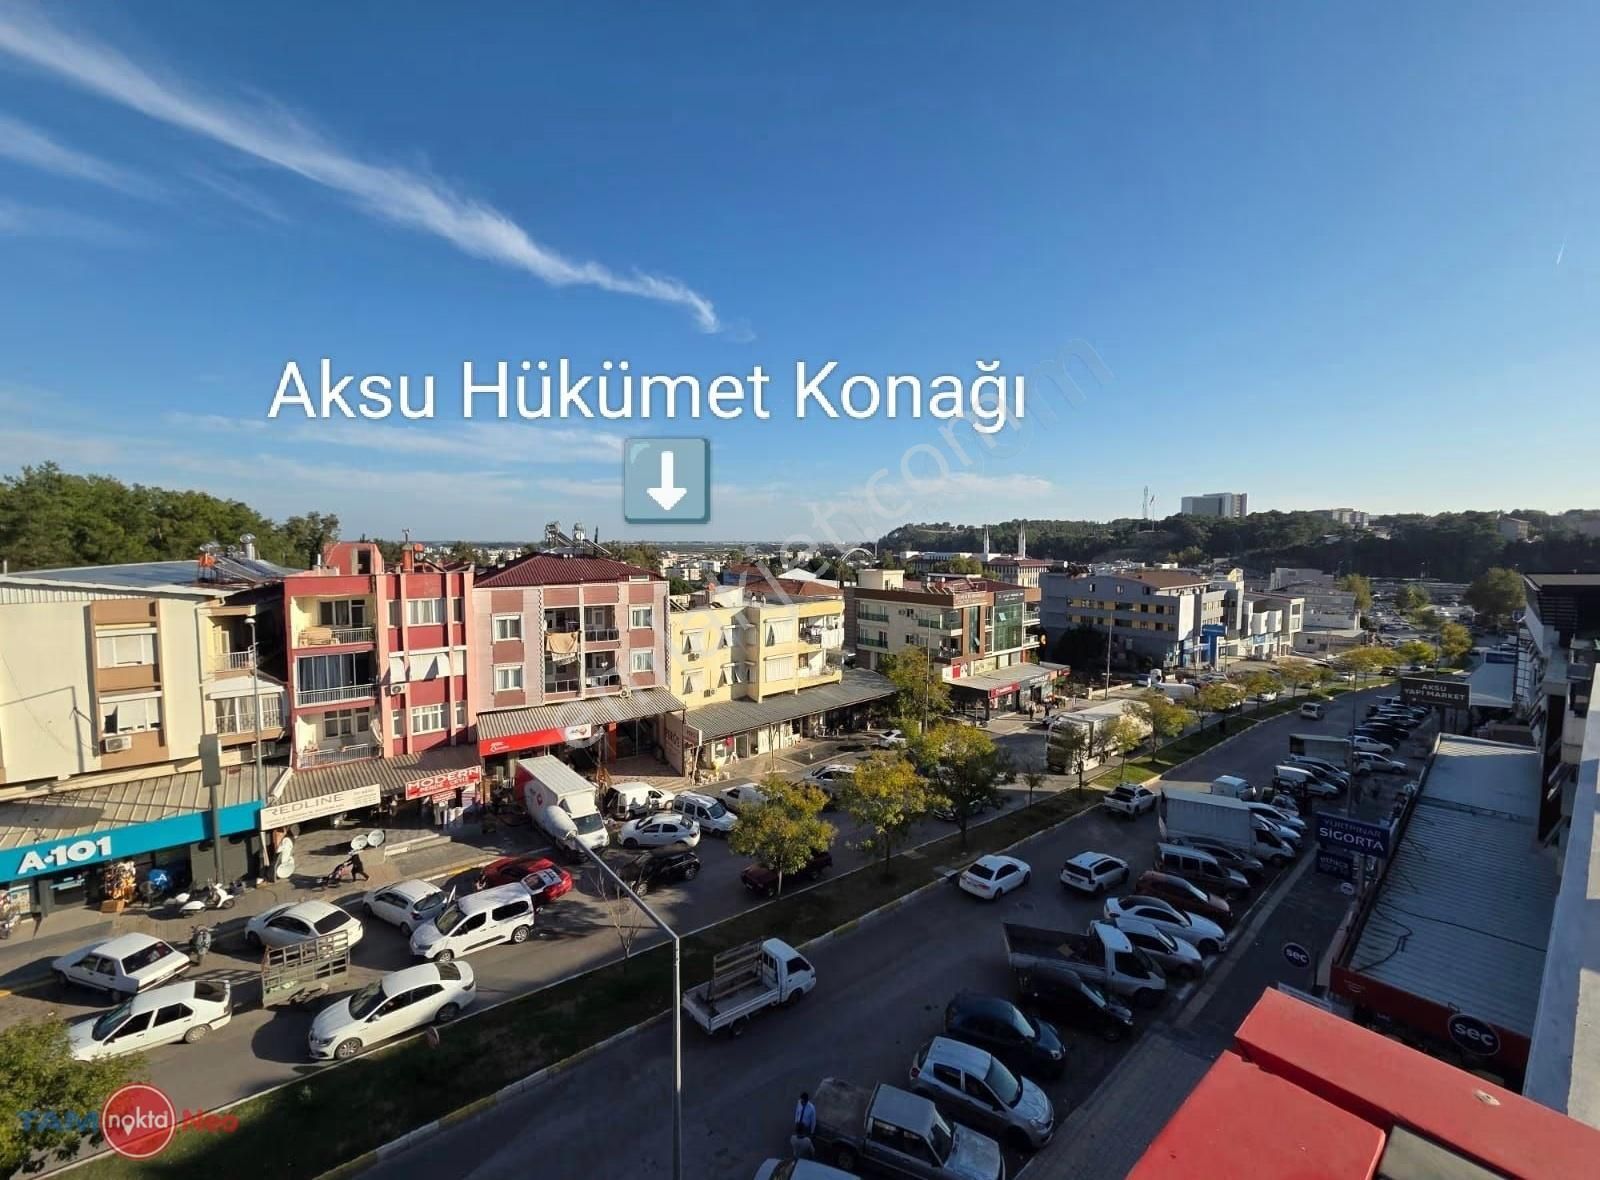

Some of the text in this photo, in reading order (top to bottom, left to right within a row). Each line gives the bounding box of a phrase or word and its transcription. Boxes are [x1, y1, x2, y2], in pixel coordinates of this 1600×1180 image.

[1422, 684, 1446, 692] AKSU
[1426, 691, 1464, 700] MARKET
[407, 766, 480, 788] MODERN
[266, 793, 345, 816] REDLINE
[1286, 948, 1308, 963] sec
[1454, 1021, 1496, 1047] sec
